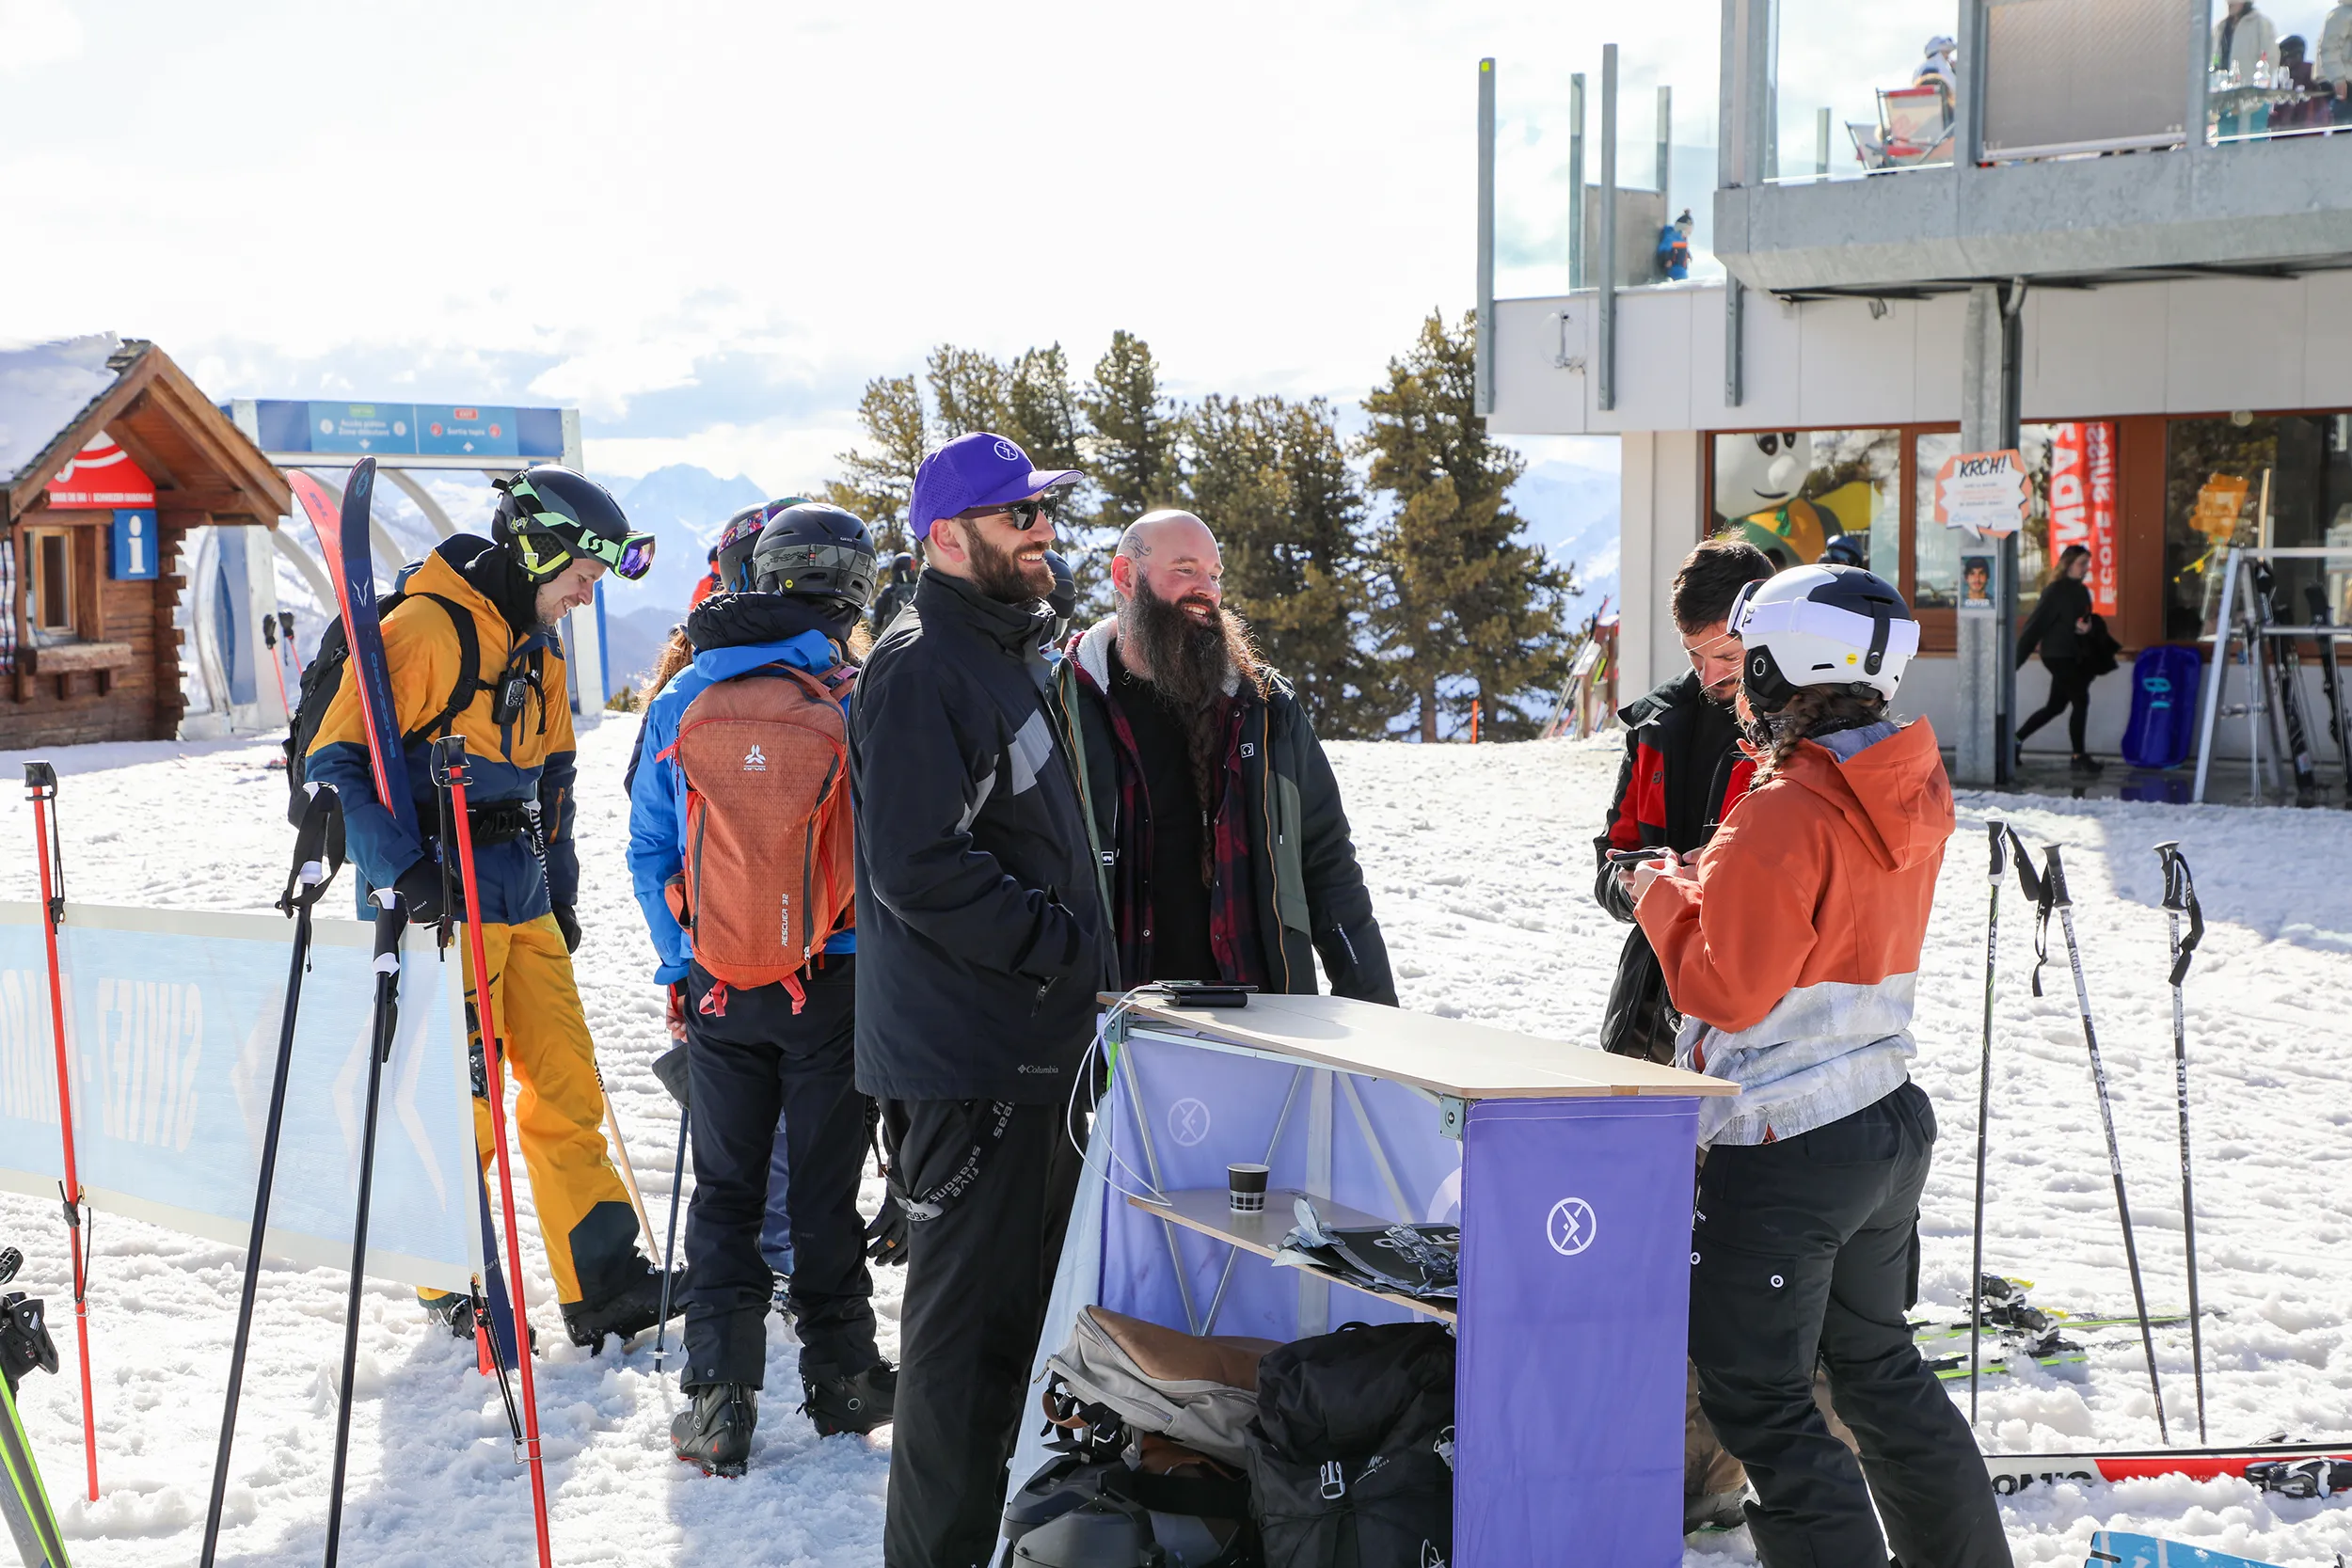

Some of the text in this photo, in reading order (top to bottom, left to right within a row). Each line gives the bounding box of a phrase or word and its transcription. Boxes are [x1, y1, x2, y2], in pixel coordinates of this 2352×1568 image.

[1960, 455, 2007, 478] KRCH!
[371, 652, 396, 758] BLIZZARD
[781, 893, 788, 906] 32
[1025, 1065, 1059, 1074] Columbia
[930, 1145, 981, 1202] seasons
[950, 1166, 979, 1197] five
